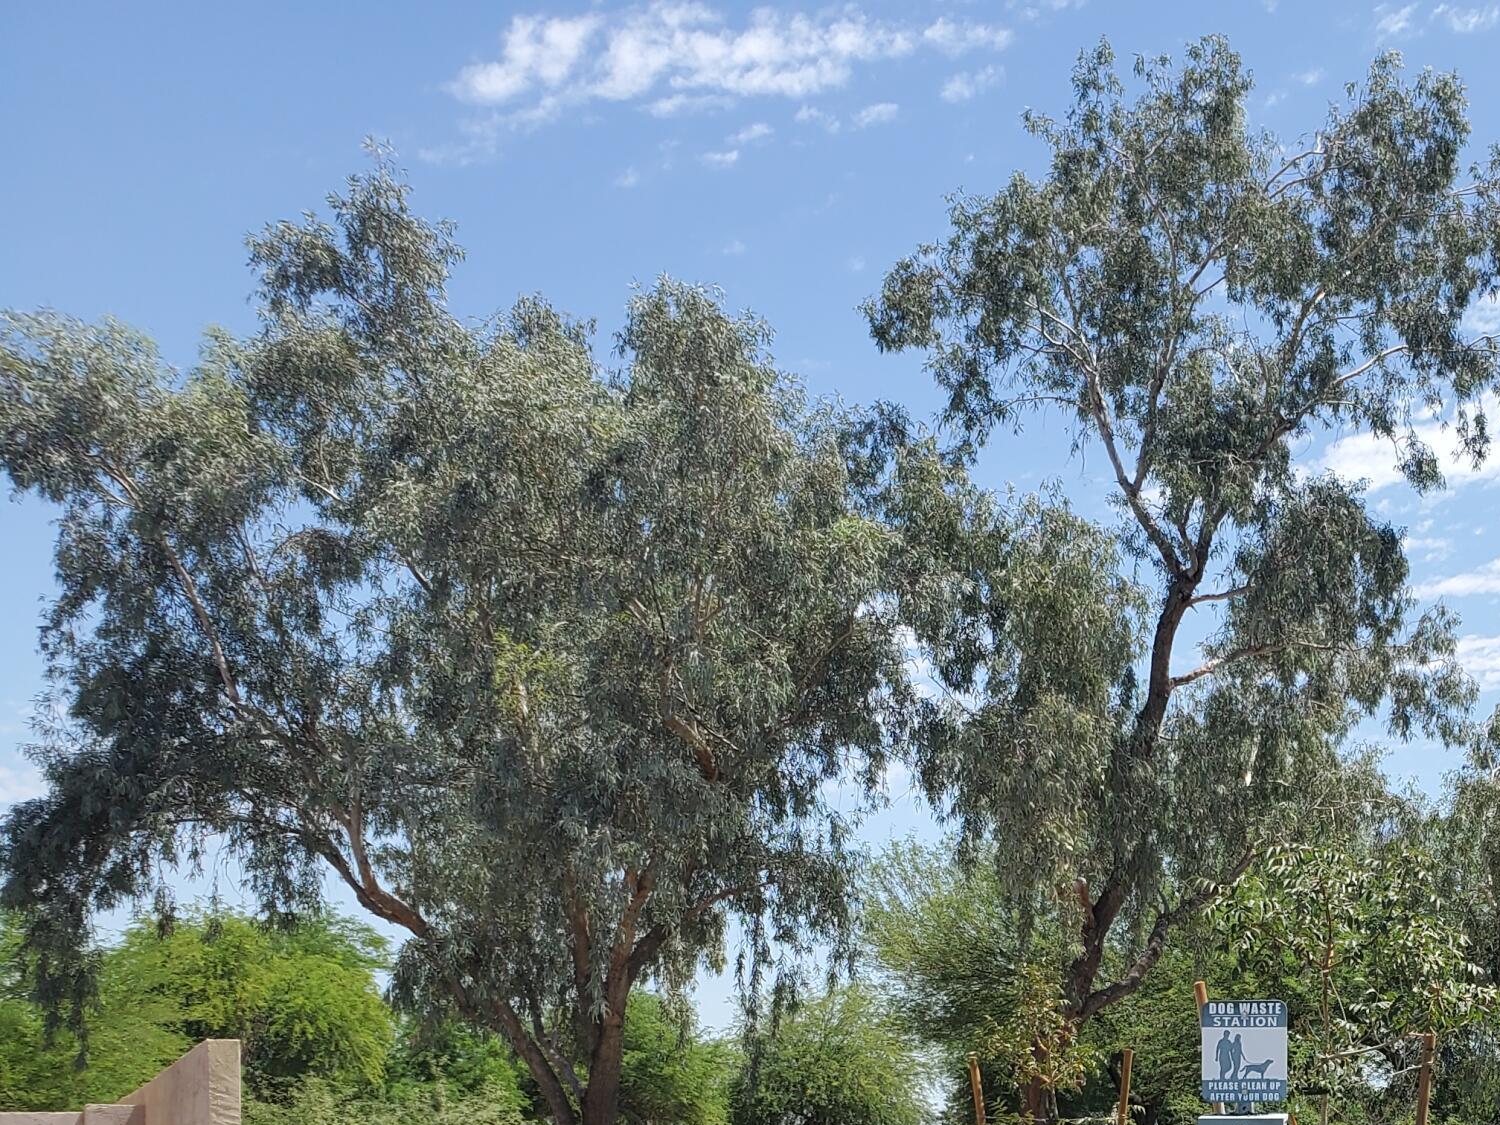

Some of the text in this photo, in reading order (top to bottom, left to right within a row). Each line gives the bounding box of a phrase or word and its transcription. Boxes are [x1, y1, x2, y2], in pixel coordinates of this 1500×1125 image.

[1209, 1003, 1281, 1014] DOG WASTE
[1213, 1017, 1277, 1026] STATION
[1208, 1082, 1281, 1090] PLEASE CLEAN UP
[1210, 1093, 1280, 1101] AFTER YOUR DOG
